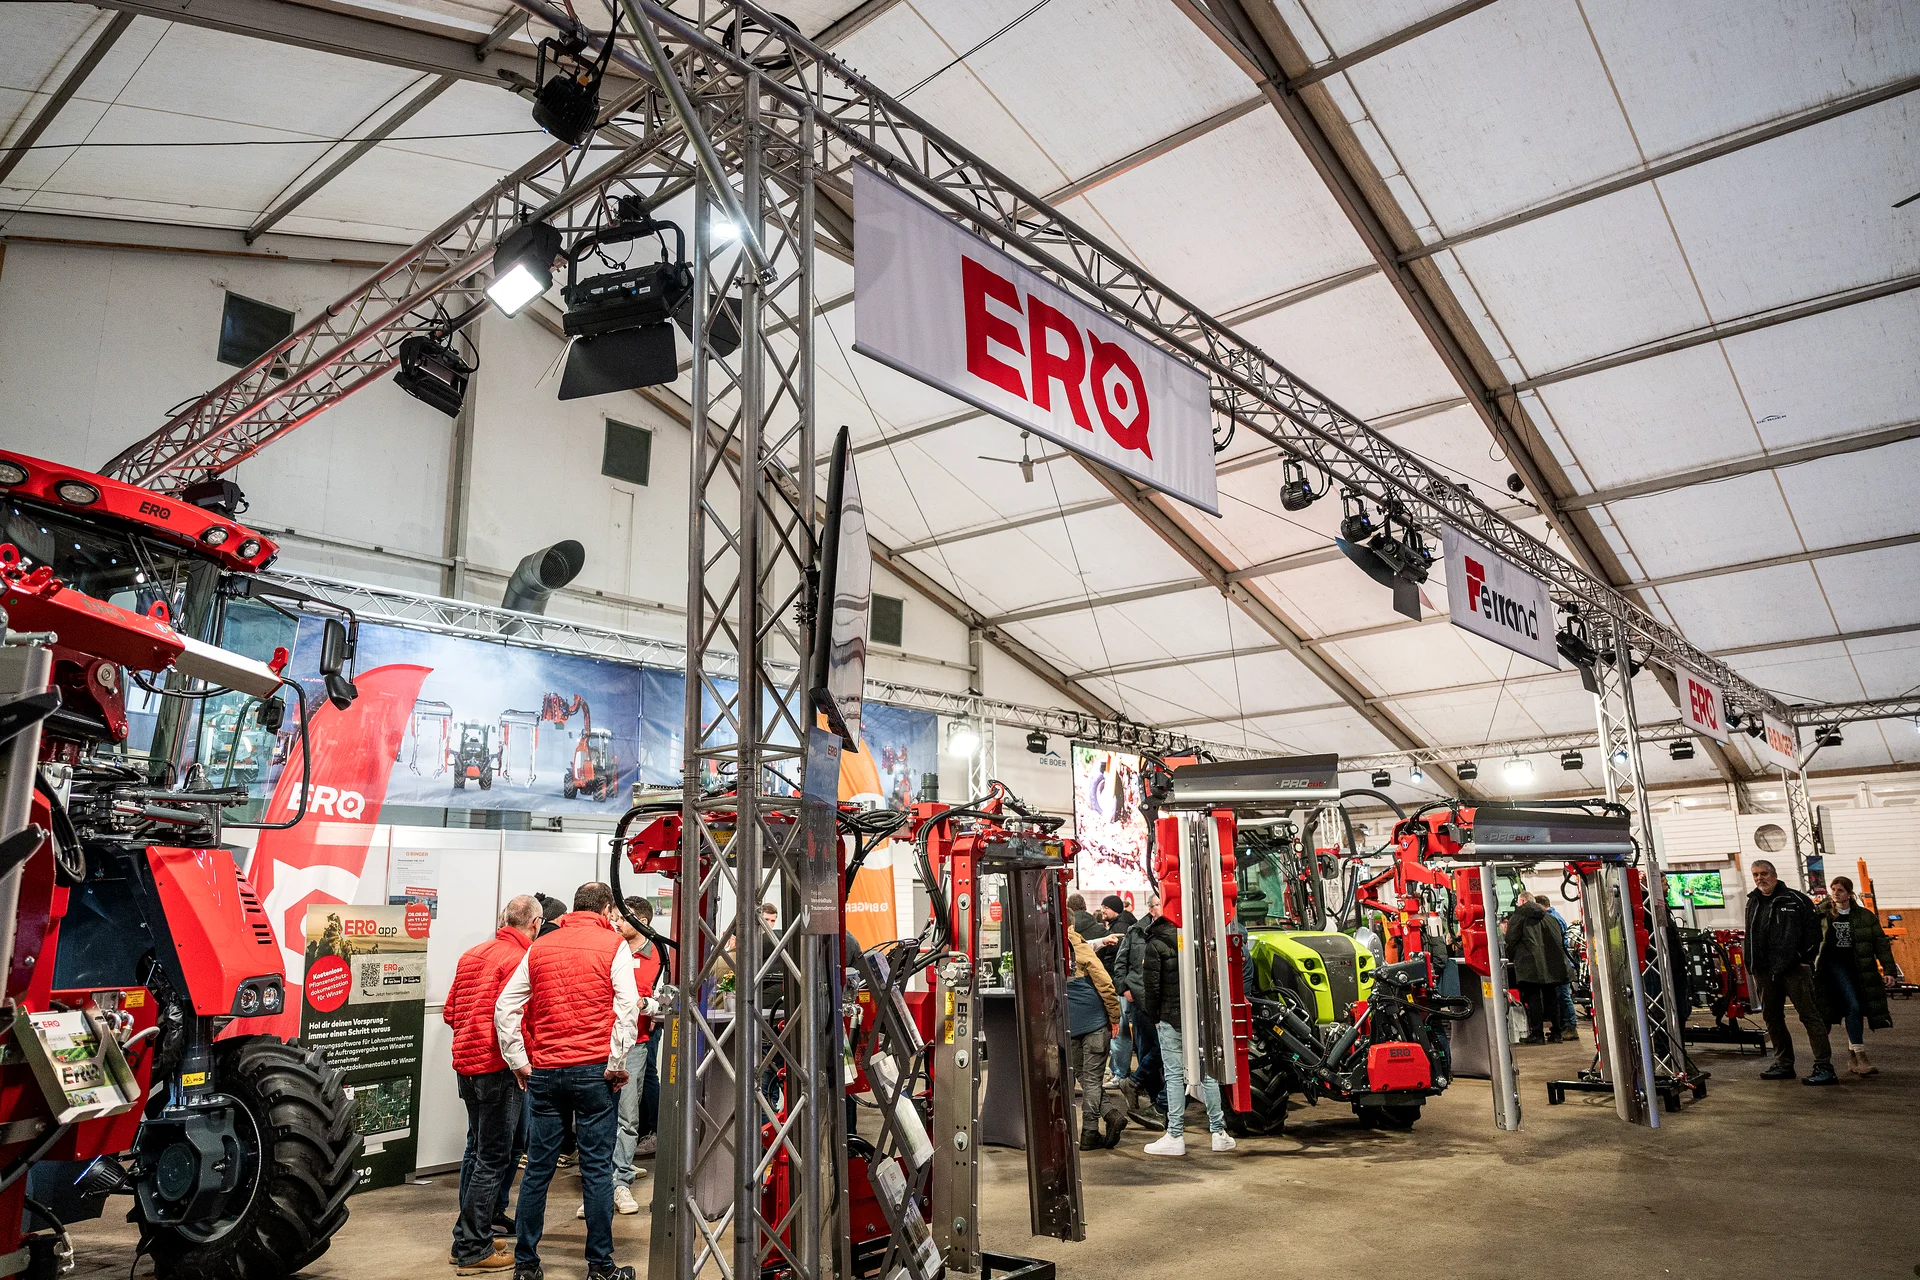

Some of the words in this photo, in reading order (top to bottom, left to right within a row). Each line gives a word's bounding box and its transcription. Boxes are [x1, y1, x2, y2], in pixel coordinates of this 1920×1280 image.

[1464, 555, 1540, 641] Ferrand
[1039, 757, 1048, 765] DE
[1049, 759, 1067, 767] BOER
[378, 924, 398, 937] app
[312, 967, 343, 980] Kostenlose
[310, 980, 349, 996] dokumentation
[325, 989, 344, 999] Winzer
[309, 1022, 321, 1030] Hol
[321, 1021, 331, 1029] dir
[330, 1020, 352, 1028] deinen
[352, 1017, 384, 1026] Vorsprung
[308, 1032, 329, 1040] immer
[329, 1030, 348, 1038] einen
[347, 1027, 370, 1036] Schritt
[370, 1026, 391, 1034] voraus
[312, 1040, 362, 1051] Planungssoftware
